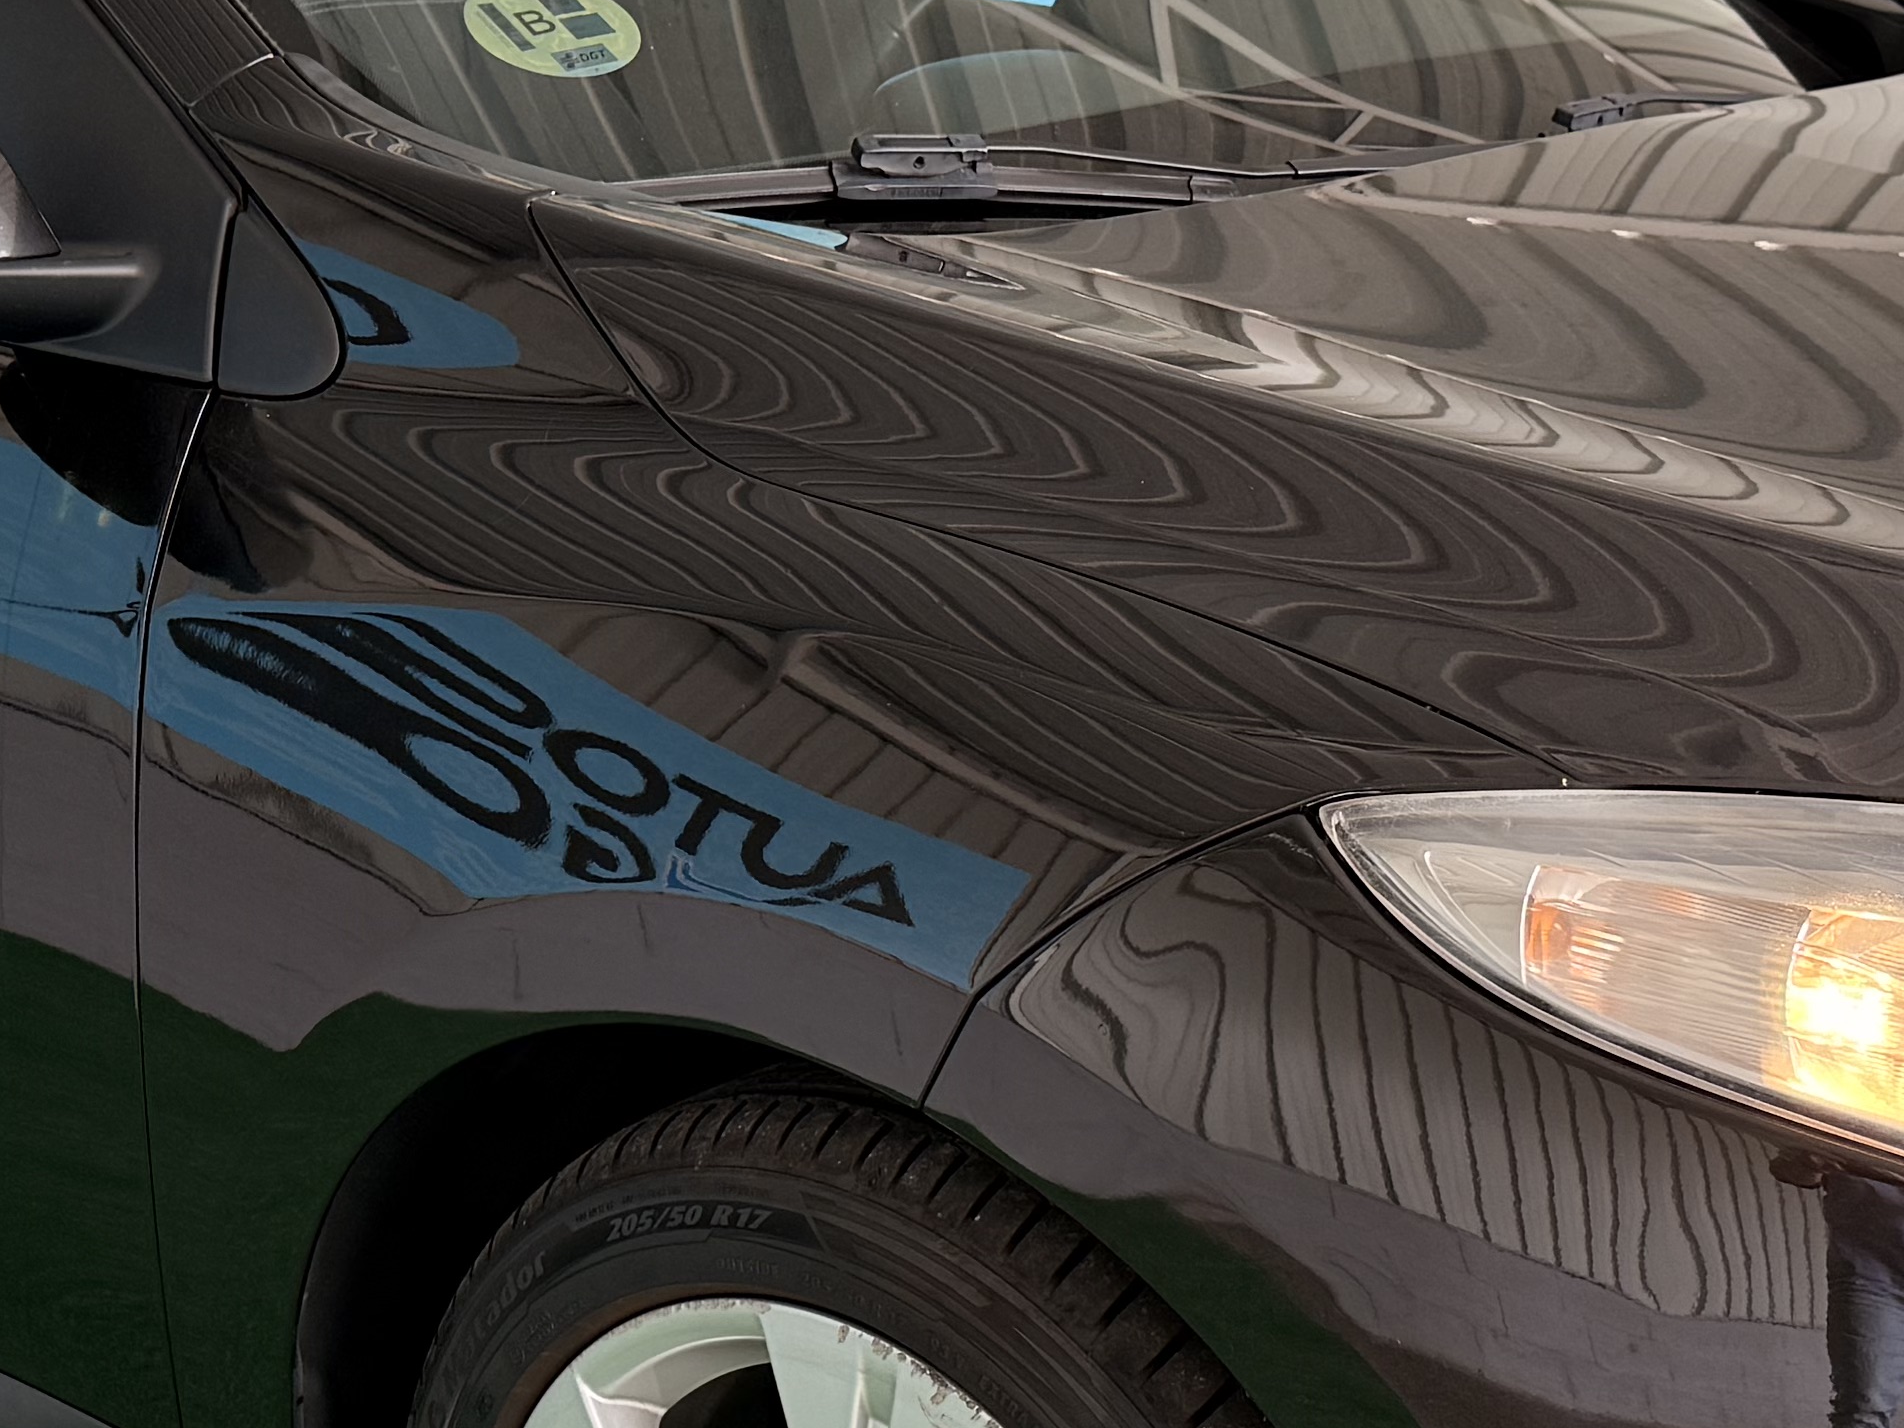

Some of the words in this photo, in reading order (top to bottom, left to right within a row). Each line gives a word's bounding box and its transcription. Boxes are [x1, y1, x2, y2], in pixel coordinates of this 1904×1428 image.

[513, 9, 556, 36] B
[579, 49, 606, 63] DGT
[605, 1203, 704, 1243] 205/50
[709, 1203, 773, 1231] R17
